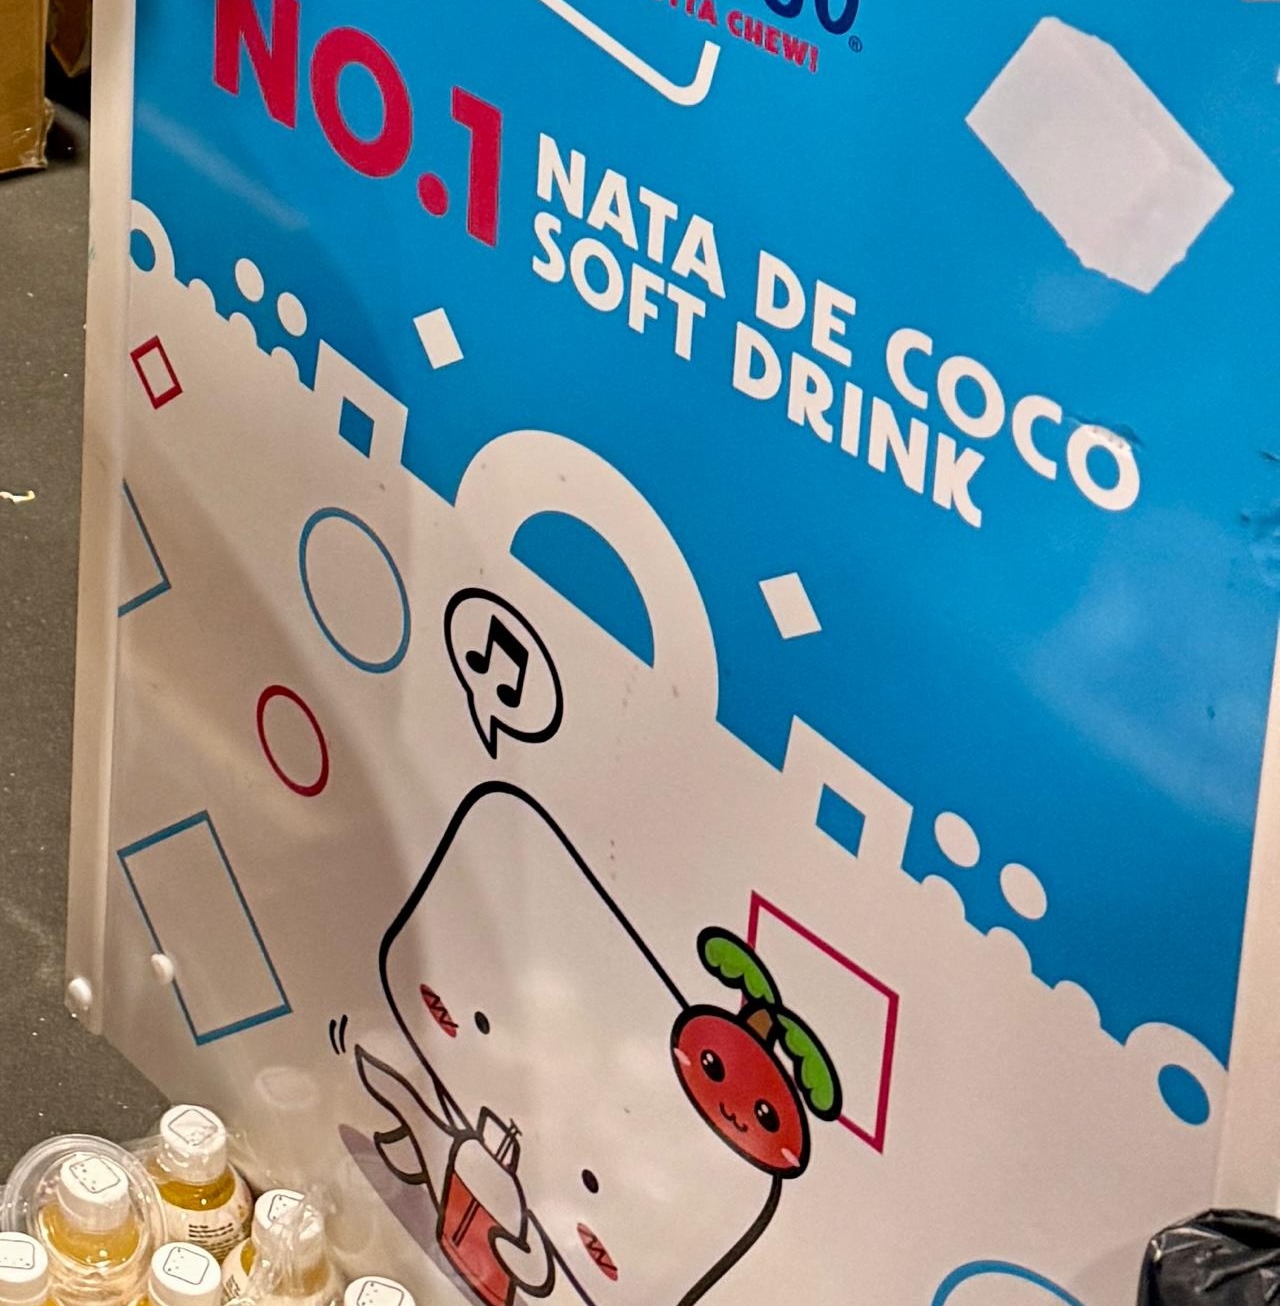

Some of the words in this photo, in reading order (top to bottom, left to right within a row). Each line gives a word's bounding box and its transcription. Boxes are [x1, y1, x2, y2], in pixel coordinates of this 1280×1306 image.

[727, 9, 819, 73] CHEW!
[532, 212, 705, 361] SOFT
[732, 321, 983, 528] DRINK
[537, 134, 725, 299] NATA
[756, 251, 855, 367] DE
[885, 328, 1139, 512] COCO
